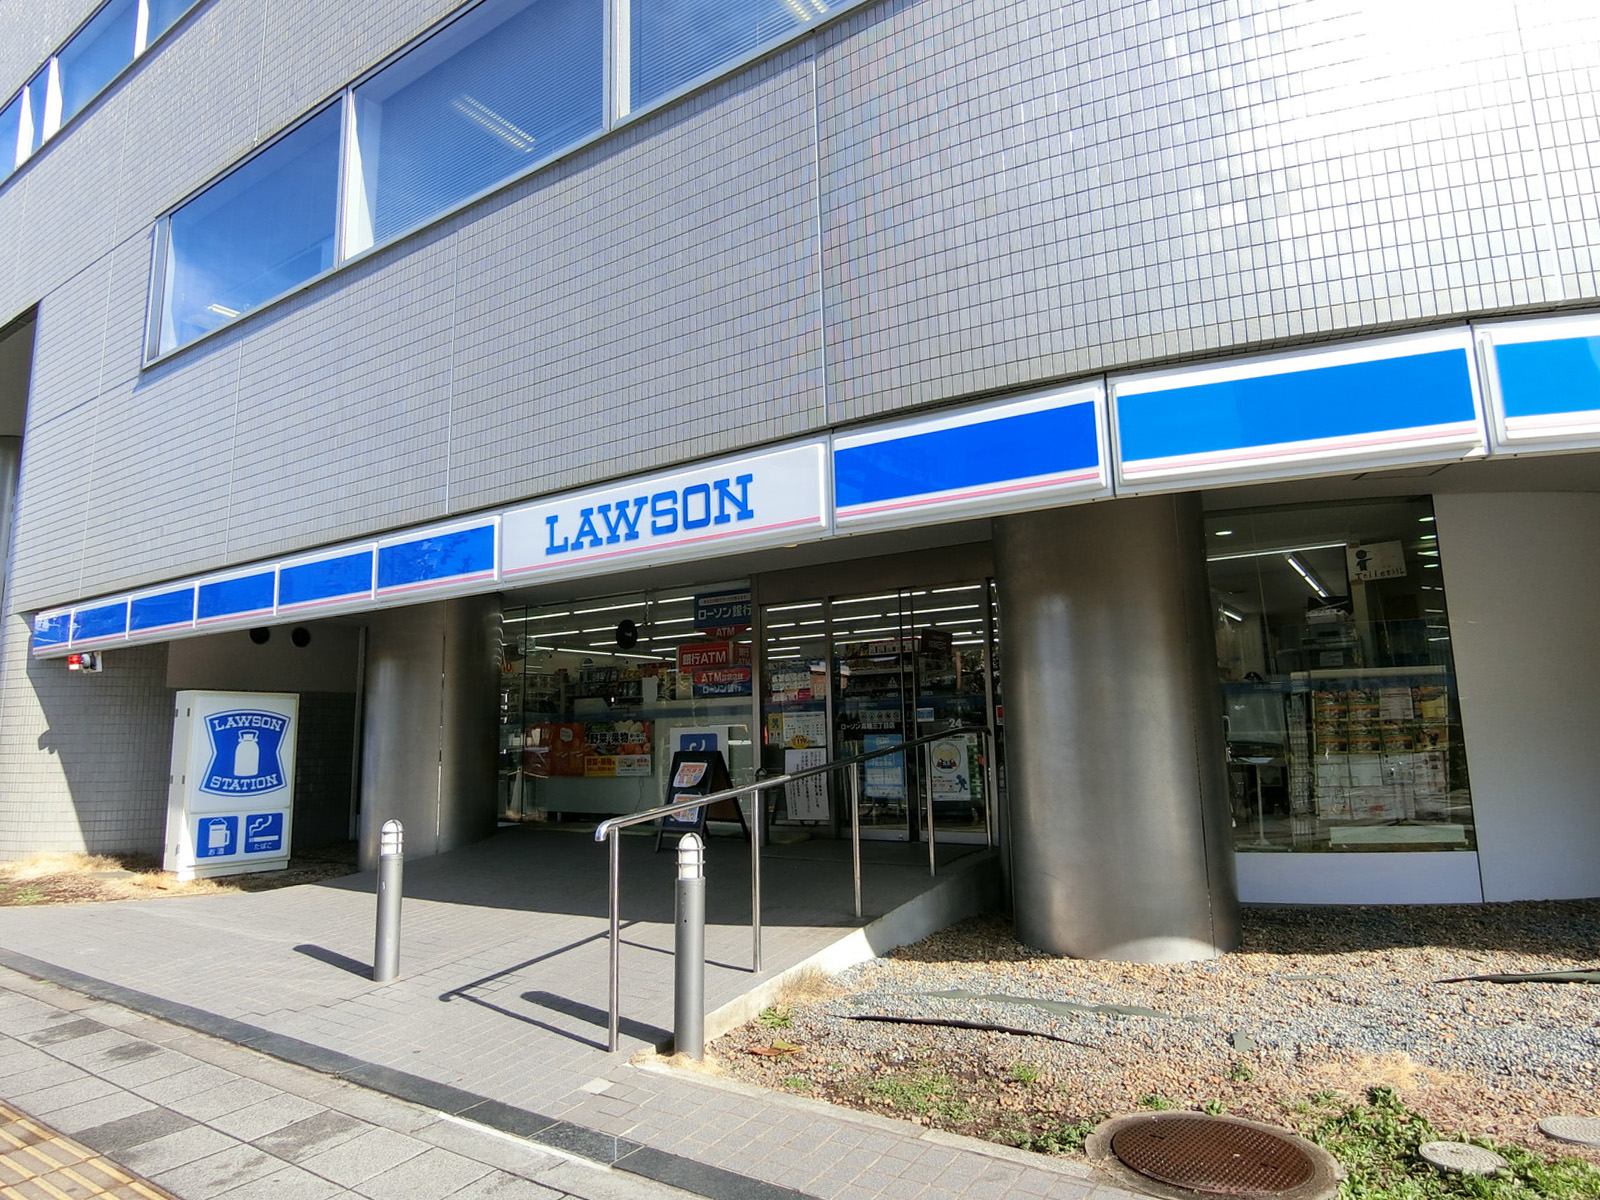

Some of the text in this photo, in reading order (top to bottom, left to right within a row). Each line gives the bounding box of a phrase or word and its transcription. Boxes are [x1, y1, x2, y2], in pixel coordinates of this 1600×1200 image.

[546, 473, 754, 555] LAWSON
[698, 604, 752, 620] ローソン銀行
[716, 626, 735, 638] ATM
[682, 650, 726, 666] 銀行ATM
[702, 682, 742, 694] ローソン銀行
[213, 716, 282, 731] LAWSON
[948, 718, 963, 728] 24
[589, 731, 629, 745] 野菜・果物
[210, 774, 278, 791] STATION
[208, 847, 225, 856] お酒
[253, 842, 273, 850] たばこ
